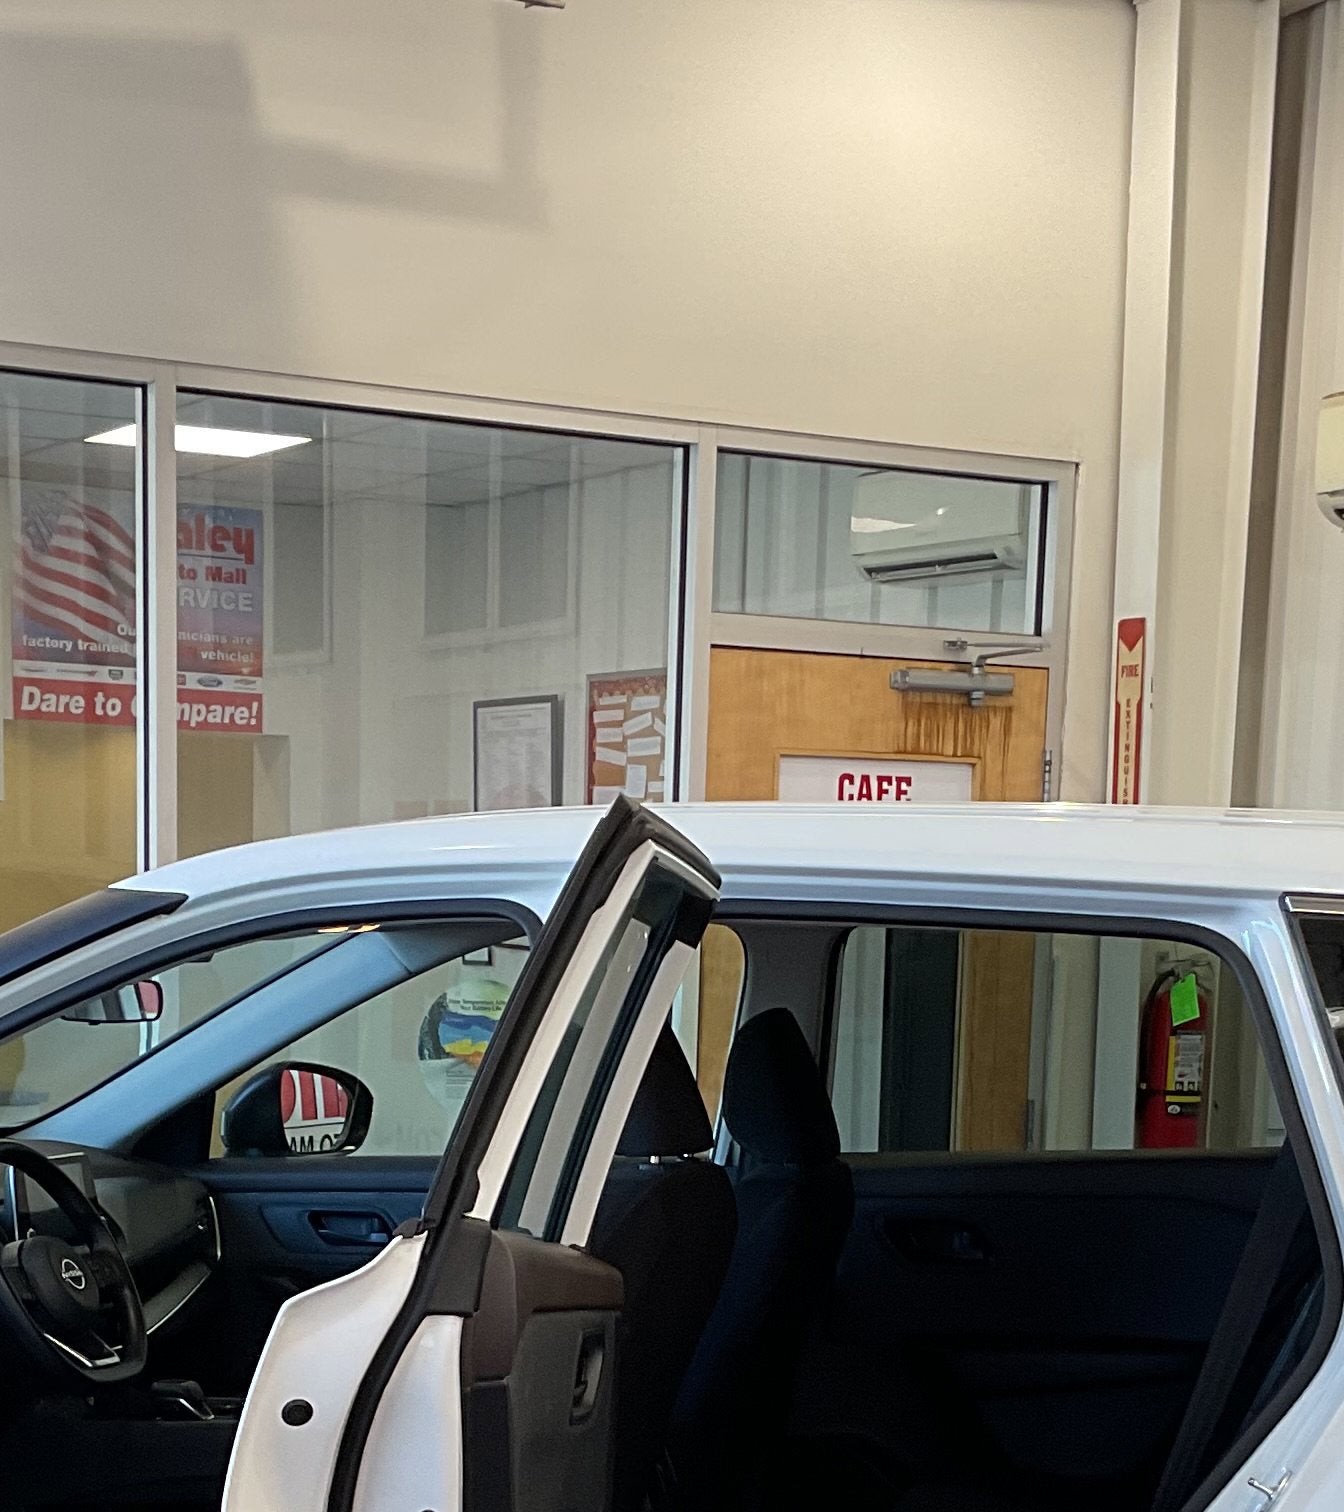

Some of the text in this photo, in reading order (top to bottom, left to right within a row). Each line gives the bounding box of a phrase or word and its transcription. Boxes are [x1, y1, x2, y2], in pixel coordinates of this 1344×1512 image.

[177, 511, 255, 565] aley
[178, 563, 247, 585] to Mall
[178, 587, 254, 613] RVICE
[22, 635, 73, 652] factory
[77, 639, 129, 654] trained
[117, 623, 136, 637] Ou
[178, 631, 228, 645] nicians
[1121, 663, 1140, 679] FIRE
[20, 685, 86, 715] Dare
[94, 691, 122, 717] to
[837, 772, 913, 802] CAFE
